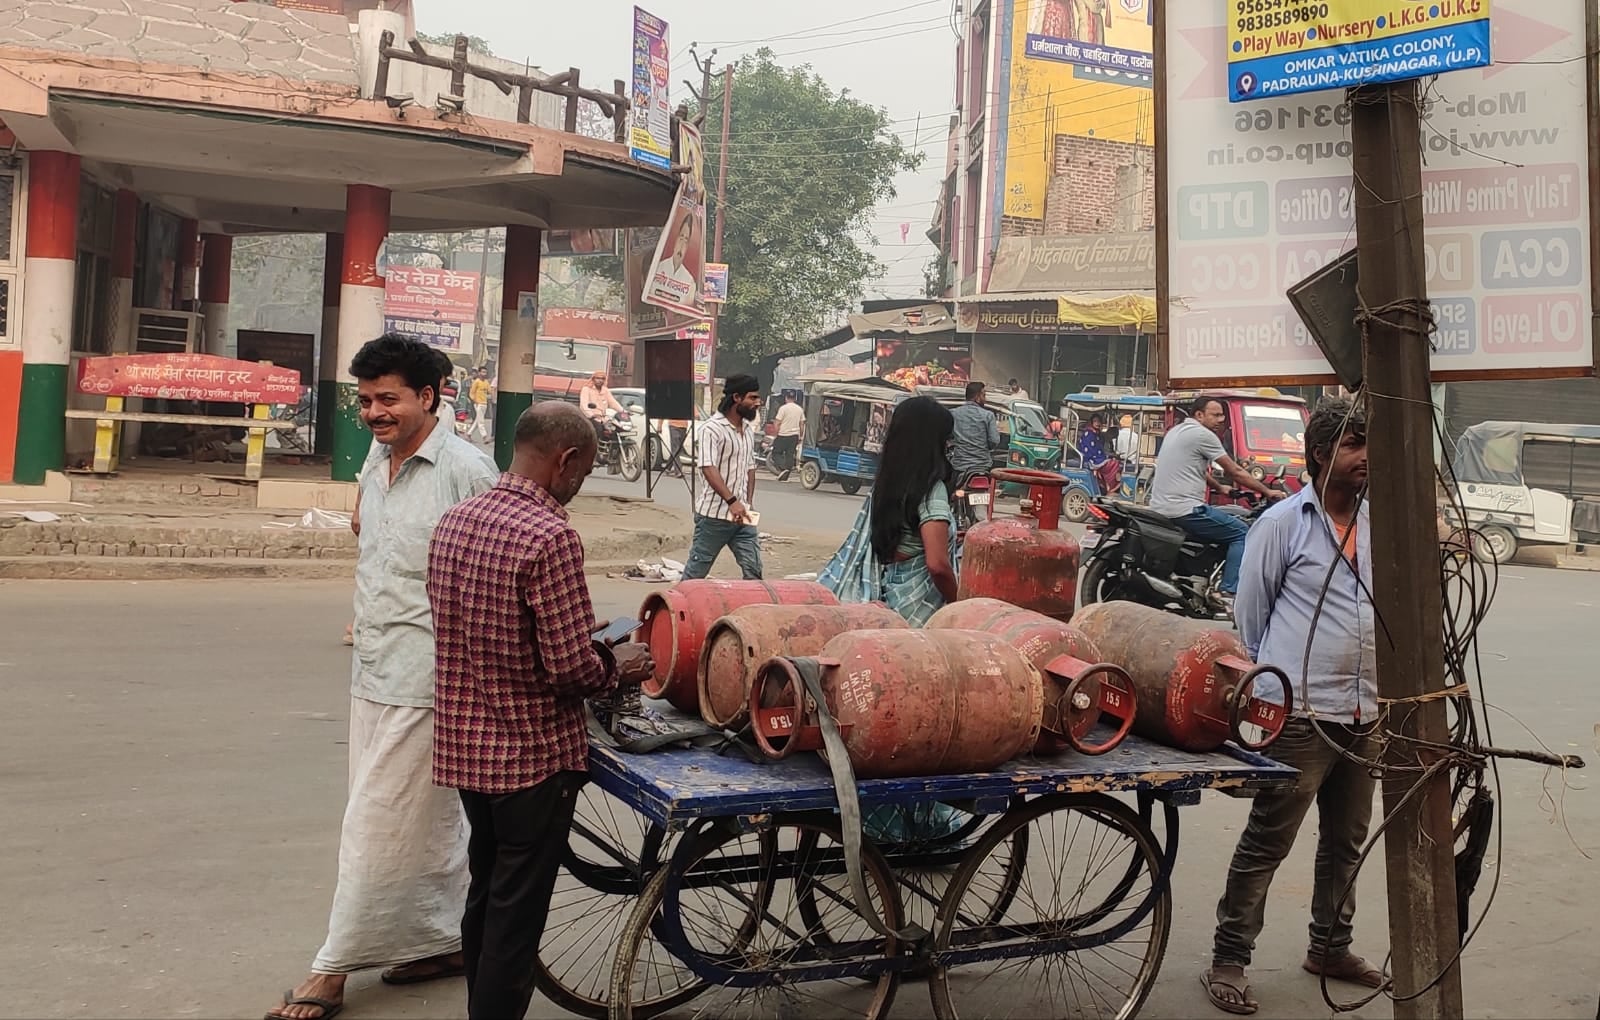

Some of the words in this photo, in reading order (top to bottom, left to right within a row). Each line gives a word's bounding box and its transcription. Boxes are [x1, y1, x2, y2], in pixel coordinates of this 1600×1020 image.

[1237, 4, 1329, 33] 9838589890
[1031, 38, 1063, 56] धर्मशाला
[1243, 35, 1272, 55] Play
[1275, 30, 1306, 49] Way
[1317, 20, 1375, 41] Nursery
[1284, 54, 1336, 74] OMKAR
[1339, 46, 1390, 66] VATIKA
[1392, 34, 1456, 57] COLONY,
[1445, 47, 1482, 67] (U.P)
[849, 671, 861, 688] WT
[840, 680, 852, 705] 15.6
[853, 687, 869, 714] NETT
[1106, 691, 1120, 708] 15.5
[770, 714, 793, 730] 15.6
[1257, 706, 1276, 721] 15.6
